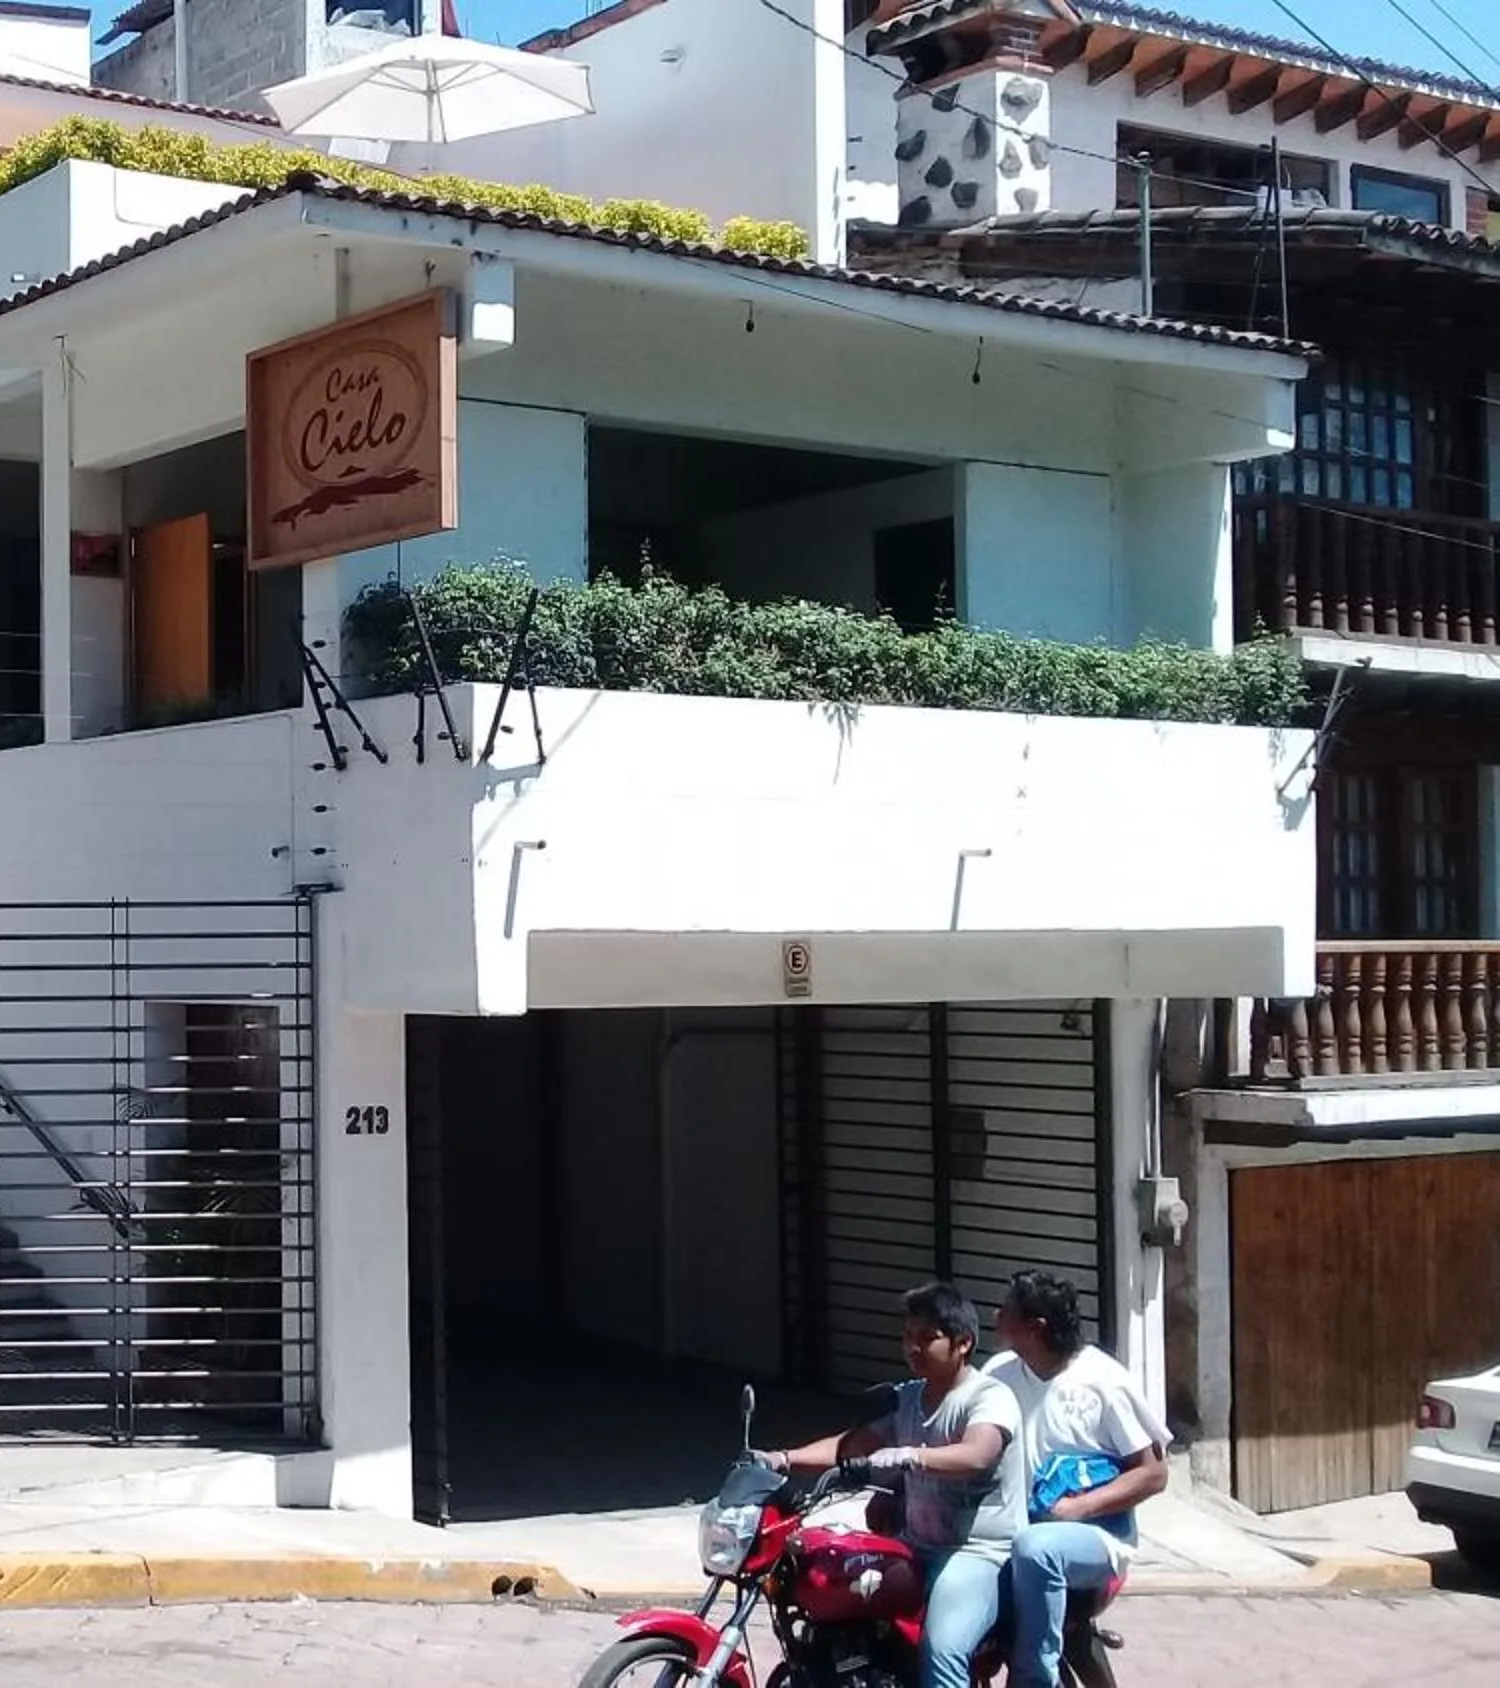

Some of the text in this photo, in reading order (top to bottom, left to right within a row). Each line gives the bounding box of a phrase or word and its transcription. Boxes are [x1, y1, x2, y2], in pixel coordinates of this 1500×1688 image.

[326, 366, 380, 402] Casa
[300, 386, 406, 472] Cielo
[791, 951, 802, 968] E
[345, 1105, 389, 1135] 213
